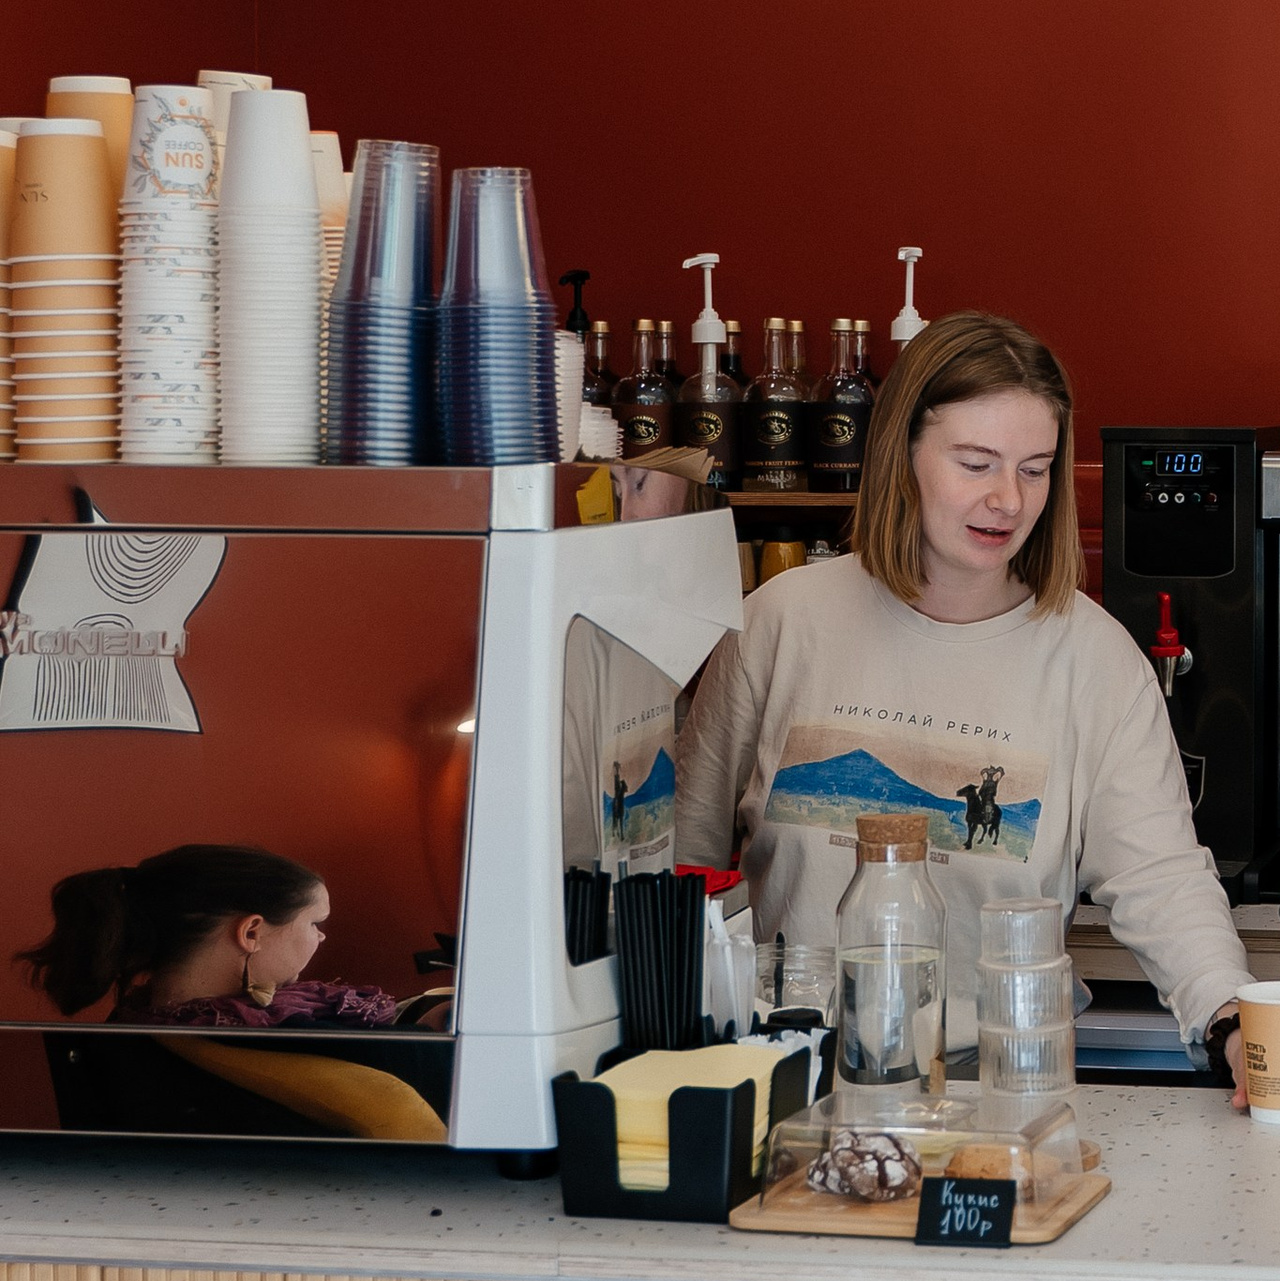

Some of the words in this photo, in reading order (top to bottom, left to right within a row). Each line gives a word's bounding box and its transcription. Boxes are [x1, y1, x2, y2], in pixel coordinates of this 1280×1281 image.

[164, 140, 204, 151] COFFEE
[164, 151, 204, 169] SUN
[1165, 454, 1202, 472] 100
[833, 704, 933, 727] НИКОЛАЙ
[946, 720, 1012, 742] РЕРИХ
[941, 1180, 1000, 1213] Кукис
[940, 1207, 993, 1237] 100р
